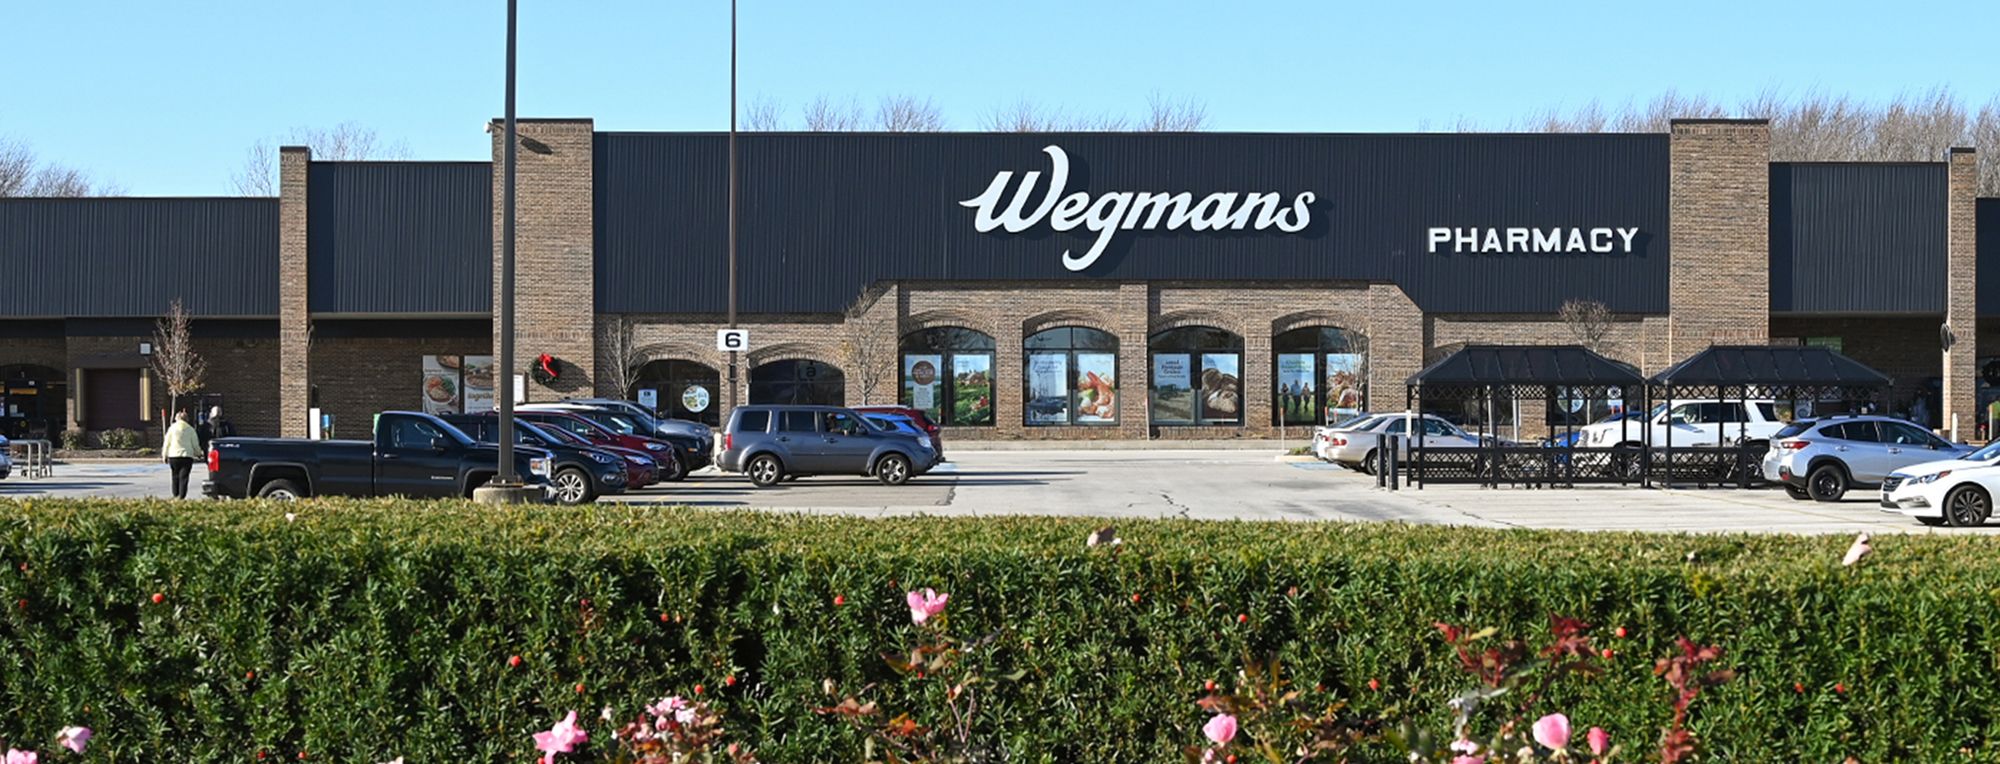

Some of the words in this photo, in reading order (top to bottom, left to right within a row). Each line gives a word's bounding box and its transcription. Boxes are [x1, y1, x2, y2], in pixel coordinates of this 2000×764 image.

[959, 144, 1316, 271] Wegmans
[1428, 226, 1639, 254] PHARMACY
[725, 332, 741, 348] 6
